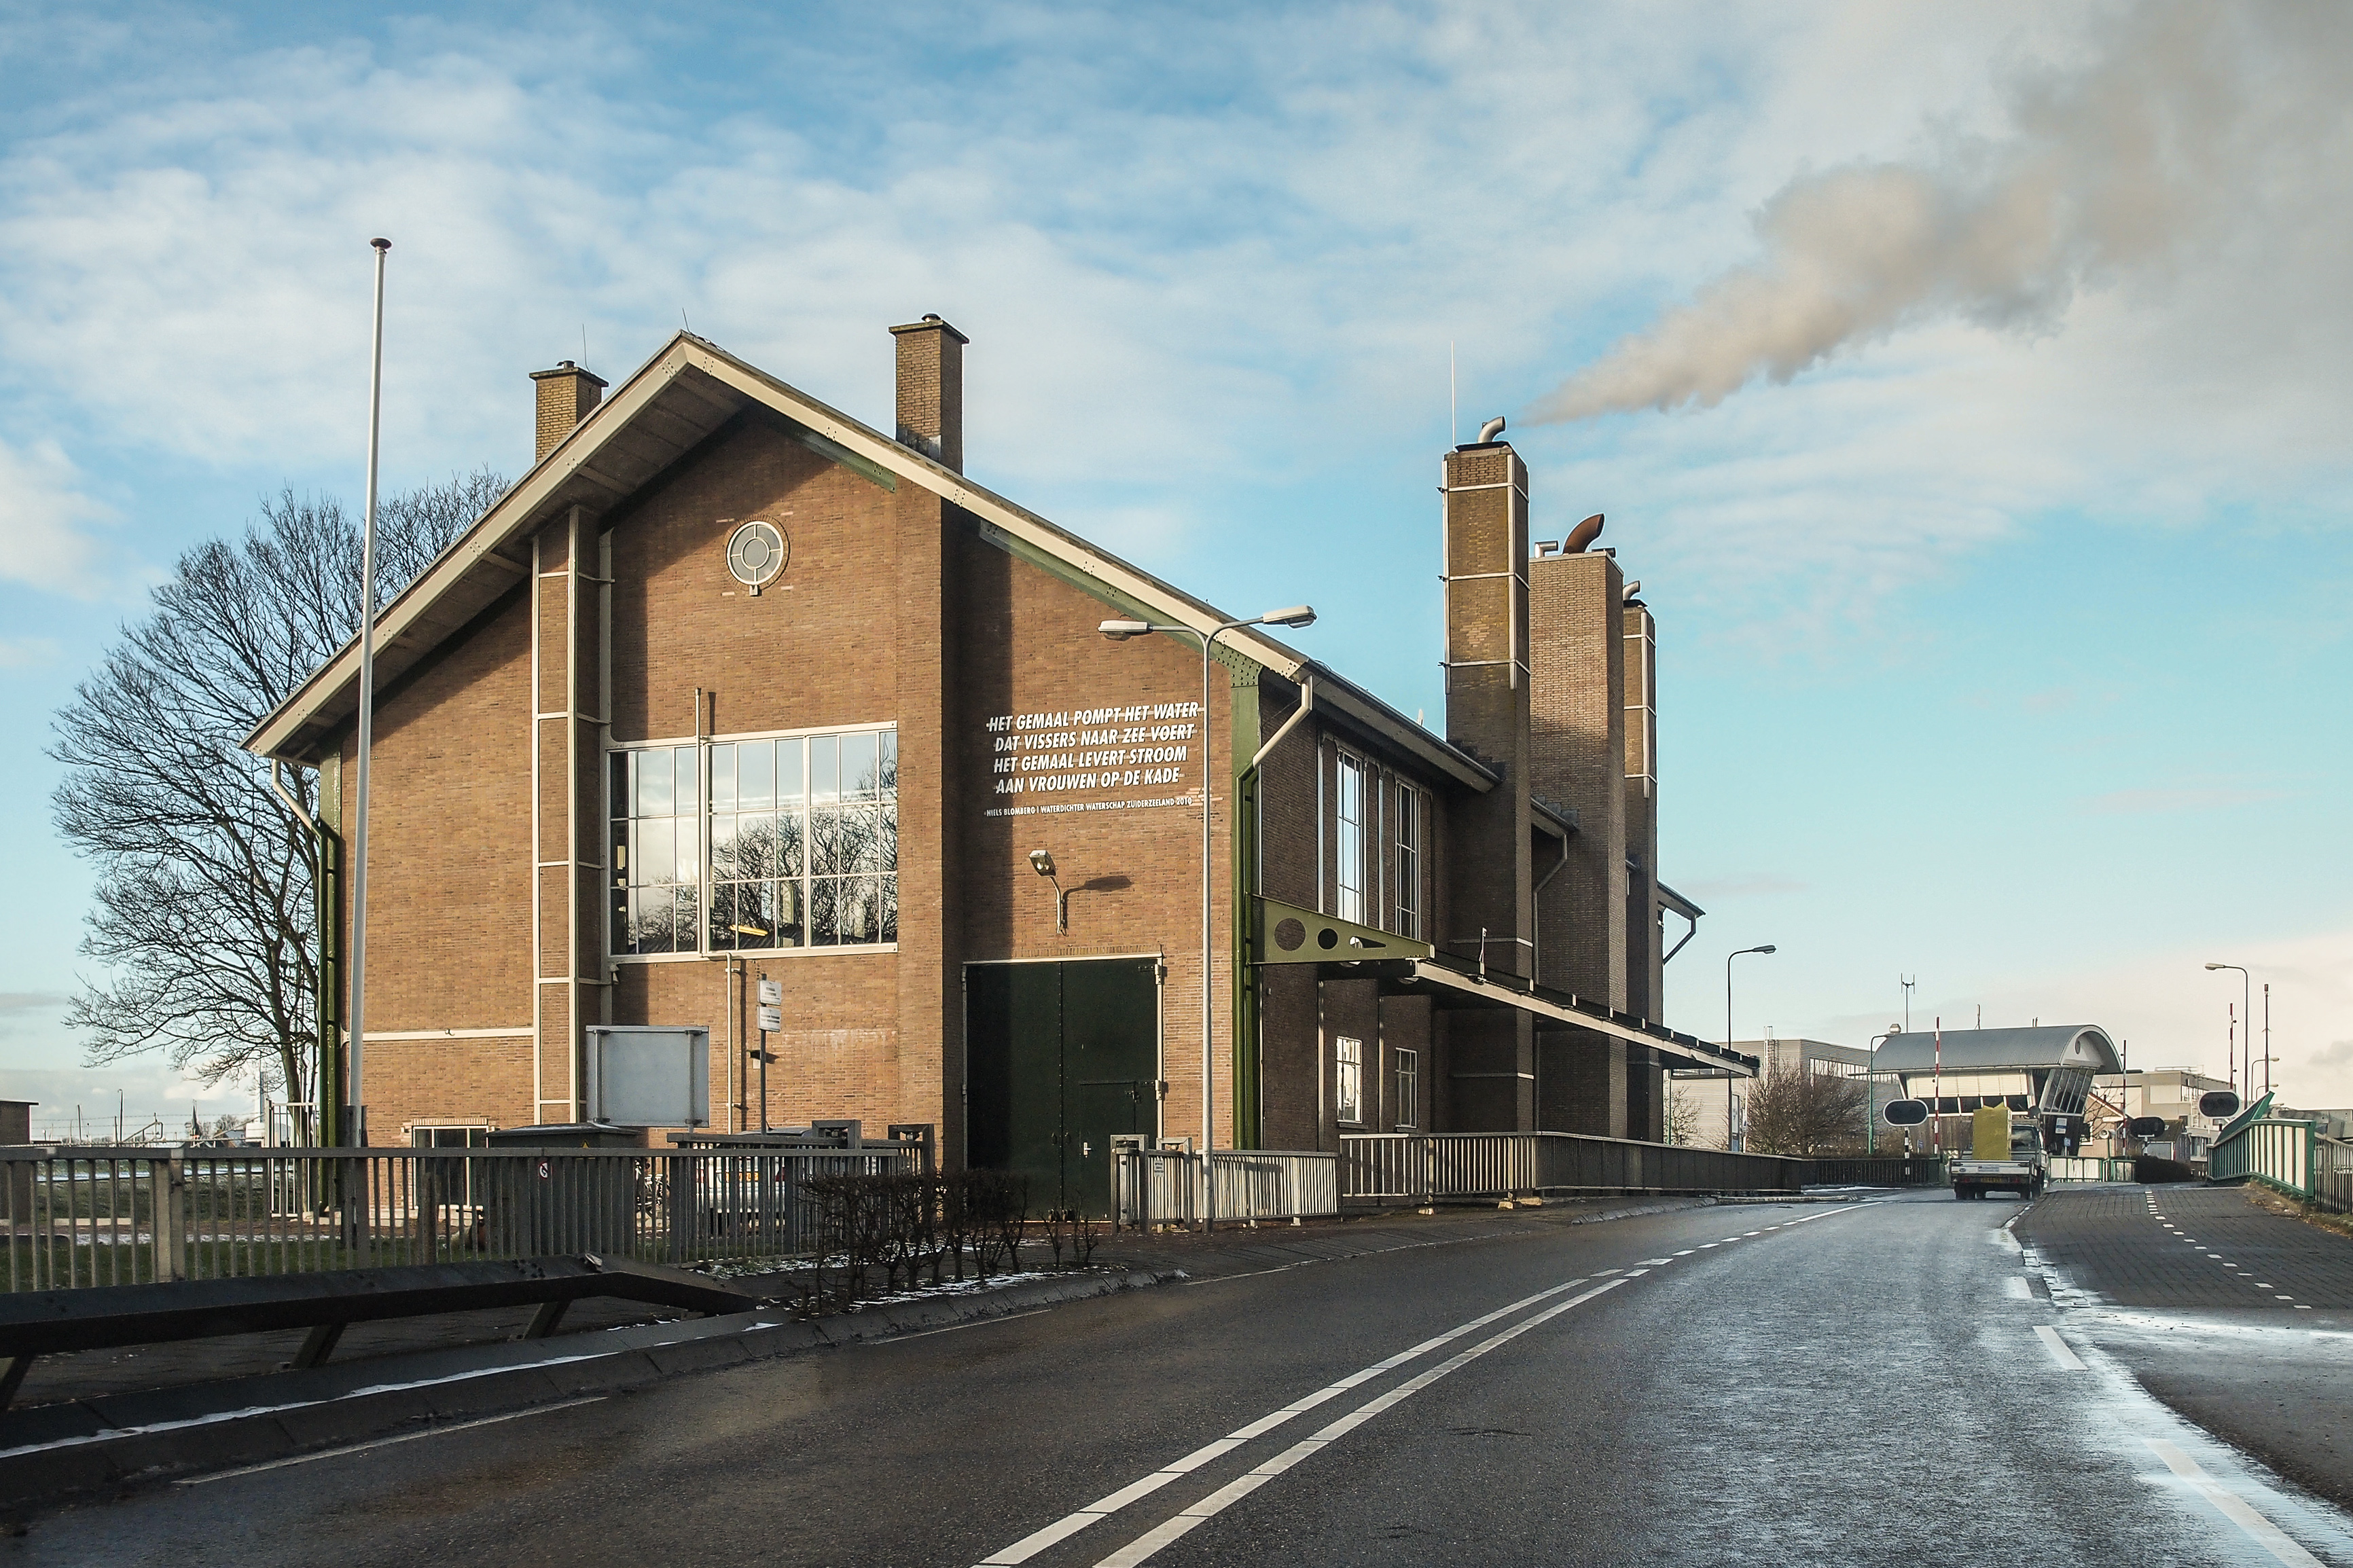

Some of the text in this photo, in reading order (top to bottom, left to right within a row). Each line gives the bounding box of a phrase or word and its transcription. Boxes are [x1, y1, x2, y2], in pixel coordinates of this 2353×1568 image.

[989, 701, 1198, 732] HET GEMAAL POMPT HET WATER
[995, 723, 1195, 752] DAT VISSERS NAAR ZEE VOERT
[994, 746, 1187, 773] HET GEMAAL LEVERT STROOM
[996, 767, 1181, 794] AAN VROUWEN OP DE KADE
[1004, 806, 1035, 816] BLOMBERG
[1041, 803, 1084, 814] WATERDICHTER
[1086, 801, 1125, 811] WATERSCHAP
[1126, 798, 1174, 808] ZUIDERZEELAND
[1176, 797, 1193, 805] 2010
